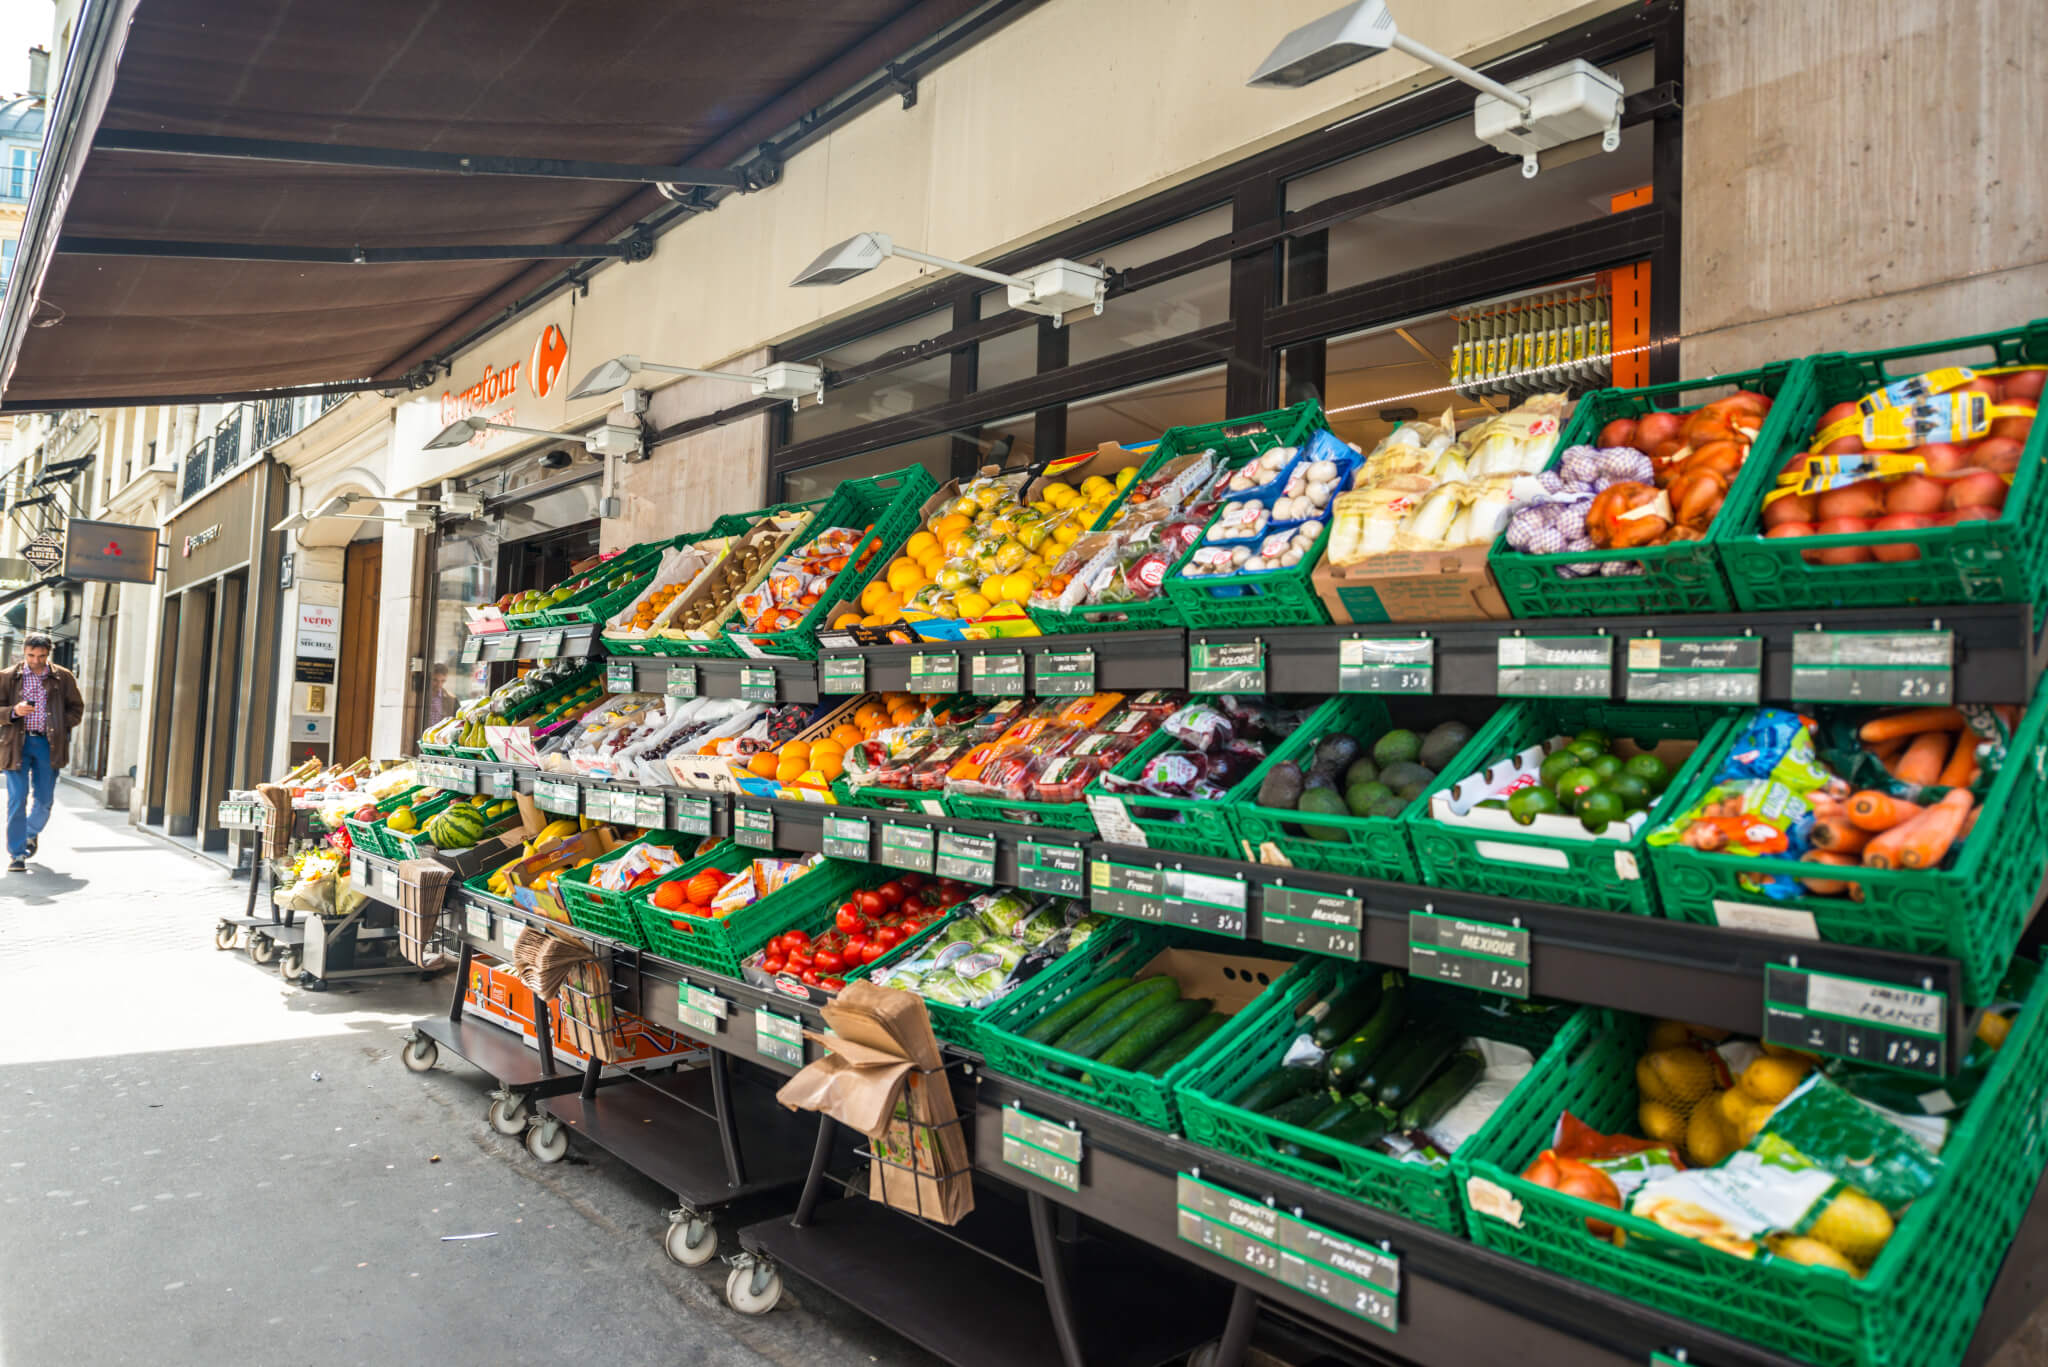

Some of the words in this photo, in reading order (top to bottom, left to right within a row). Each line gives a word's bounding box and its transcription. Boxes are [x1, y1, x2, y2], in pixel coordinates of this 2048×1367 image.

[441, 361, 520, 424] Carrefour
[26, 551, 59, 560] CLUIZEL
[303, 616, 333, 627] verny
[1312, 908, 1351, 925] Mexique
[1460, 933, 1517, 957] MEXIQUE
[1860, 1002, 1935, 1027] FRANCE
[1229, 1210, 1275, 1240] ESPAGNE
[1330, 1253, 1372, 1278] FRANCE
